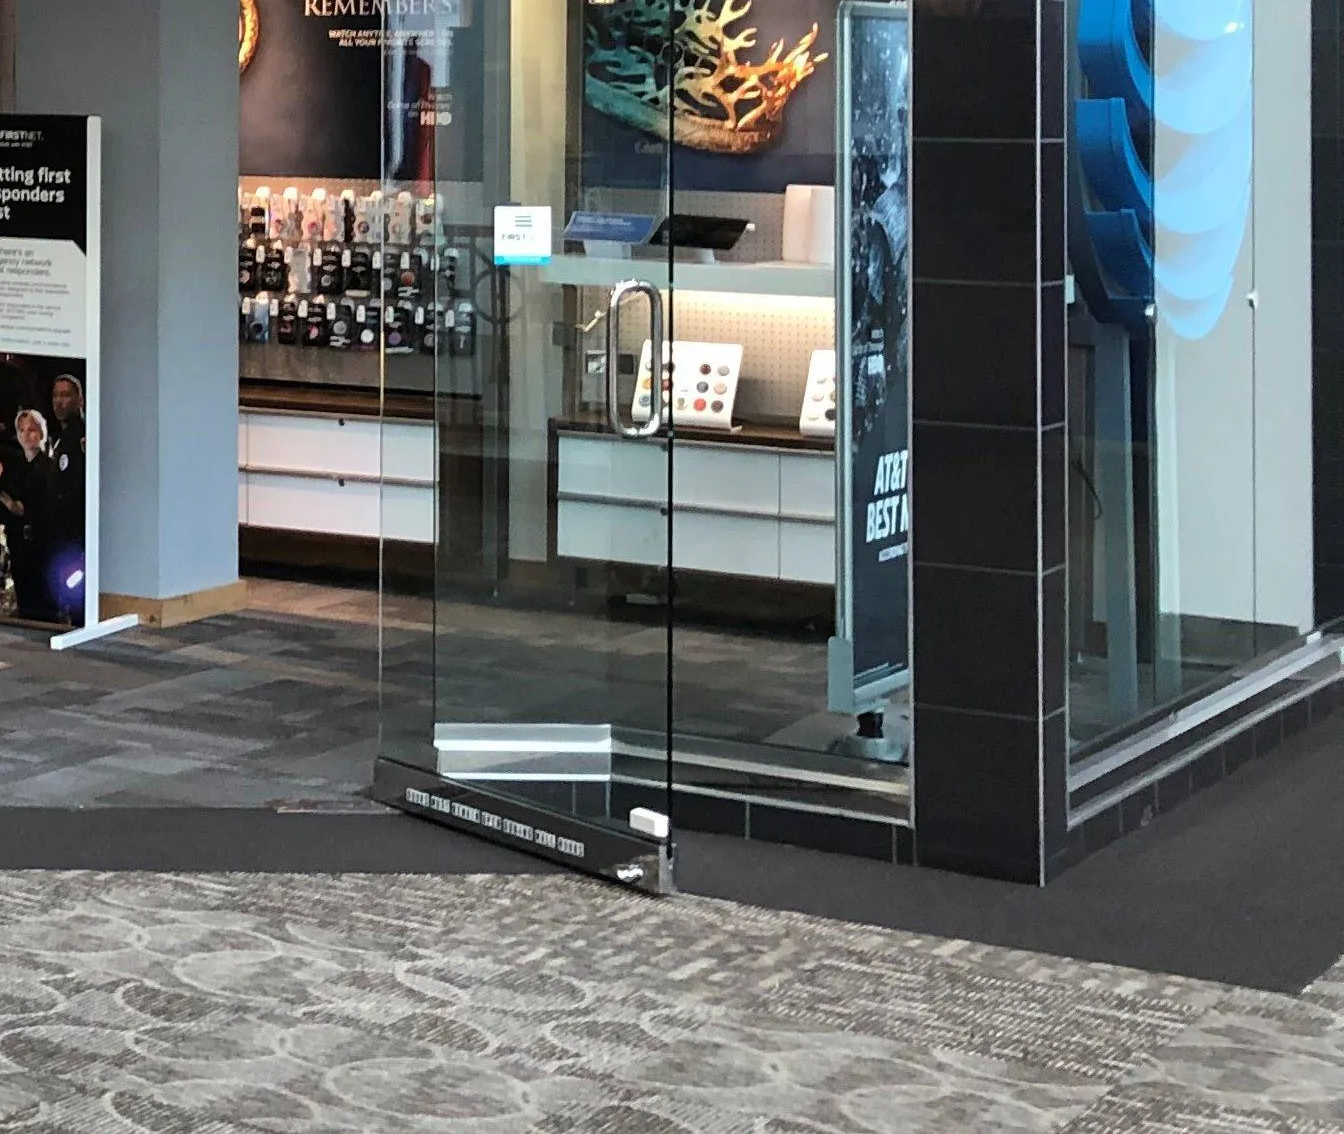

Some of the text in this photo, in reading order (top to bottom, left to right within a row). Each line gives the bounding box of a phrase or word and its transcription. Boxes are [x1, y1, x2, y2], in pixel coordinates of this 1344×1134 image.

[38, 166, 72, 184] first
[874, 449, 909, 495] AT&T
[866, 495, 900, 543] BEST
